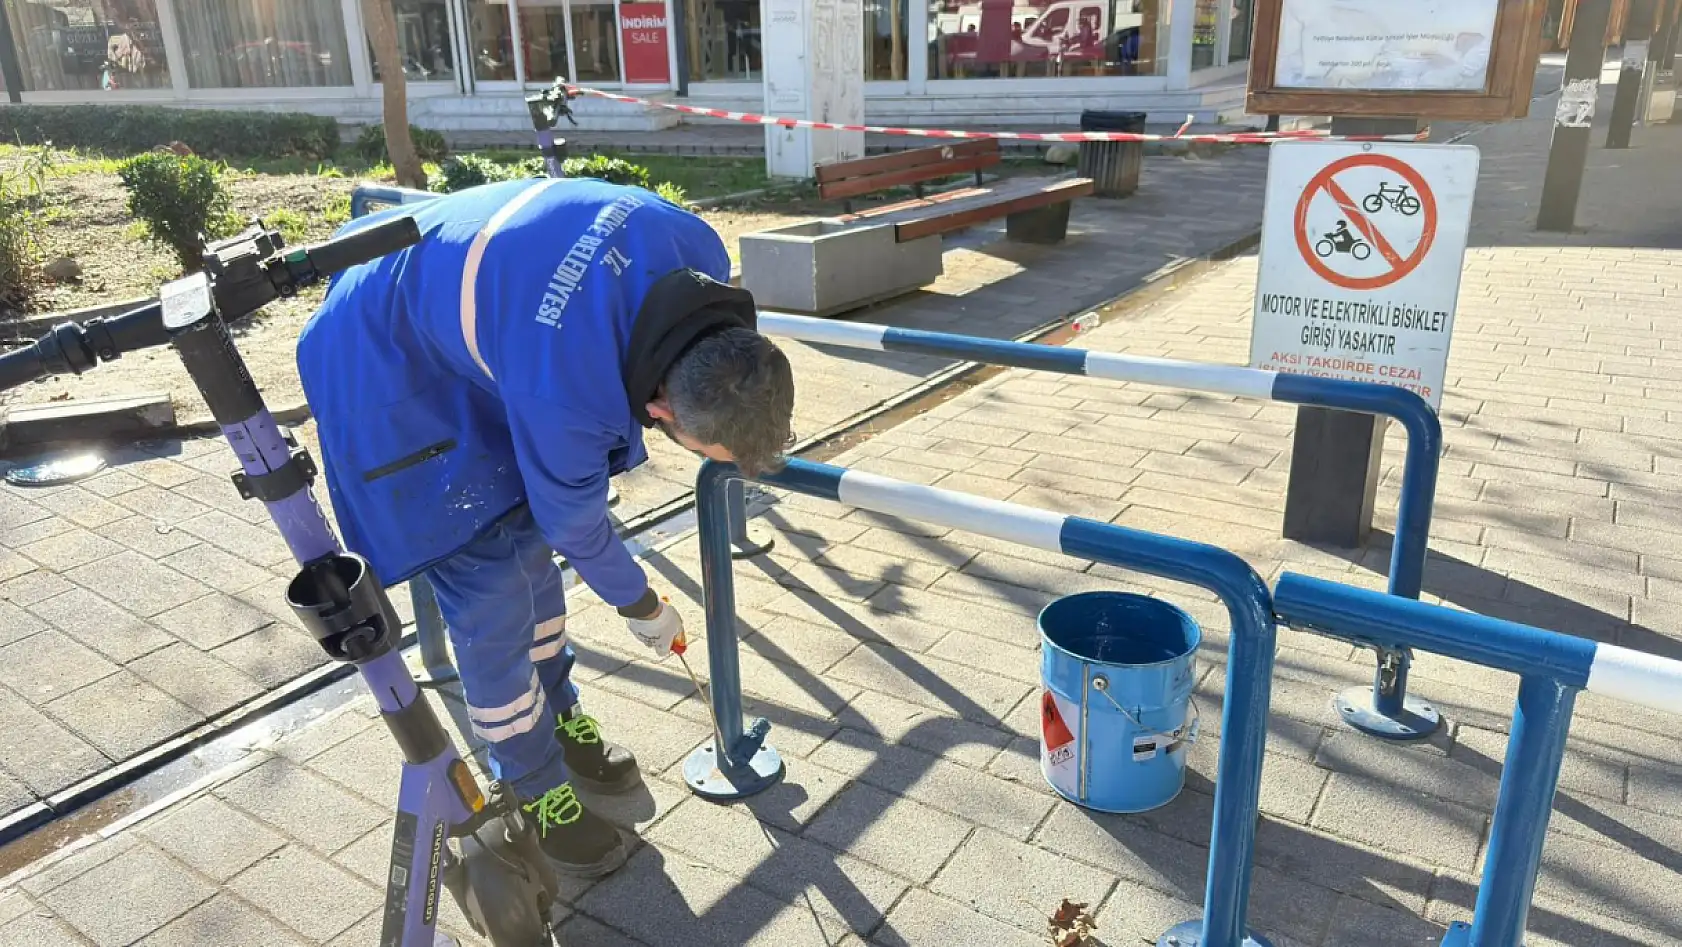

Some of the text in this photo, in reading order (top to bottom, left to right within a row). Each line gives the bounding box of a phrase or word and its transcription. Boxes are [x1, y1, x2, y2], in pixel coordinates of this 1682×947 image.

[632, 32, 659, 44] SALE
[535, 234, 604, 330] BELEDİYESİ
[1261, 293, 1448, 333] MOTOR VE ELEKTRİKLİ BİSİKLET
[1301, 321, 1395, 355] GİRİŞİ YASAKTIR
